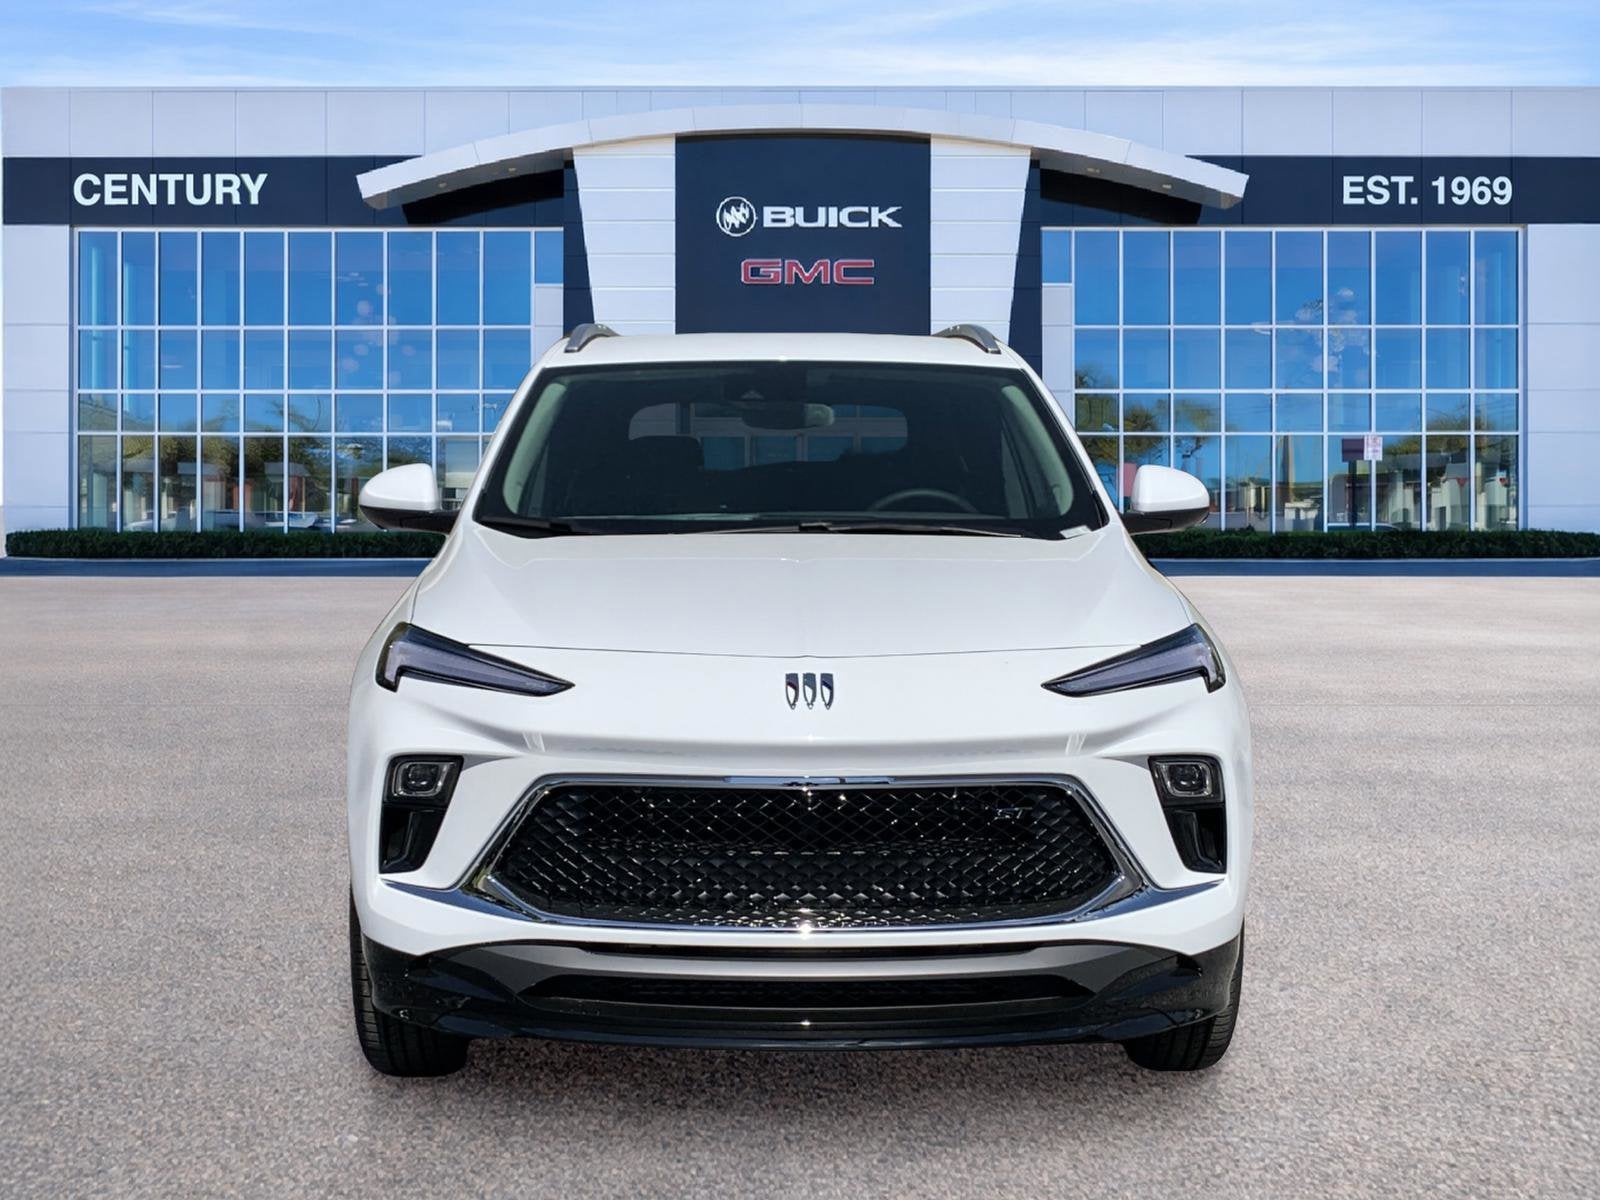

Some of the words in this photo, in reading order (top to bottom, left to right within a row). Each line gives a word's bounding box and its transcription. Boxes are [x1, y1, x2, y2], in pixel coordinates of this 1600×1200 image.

[73, 173, 268, 206] CENTURY
[1342, 175, 1419, 206] EST.
[1431, 176, 1513, 206] 1969
[763, 206, 903, 228] BUICK
[741, 259, 875, 285] GMC
